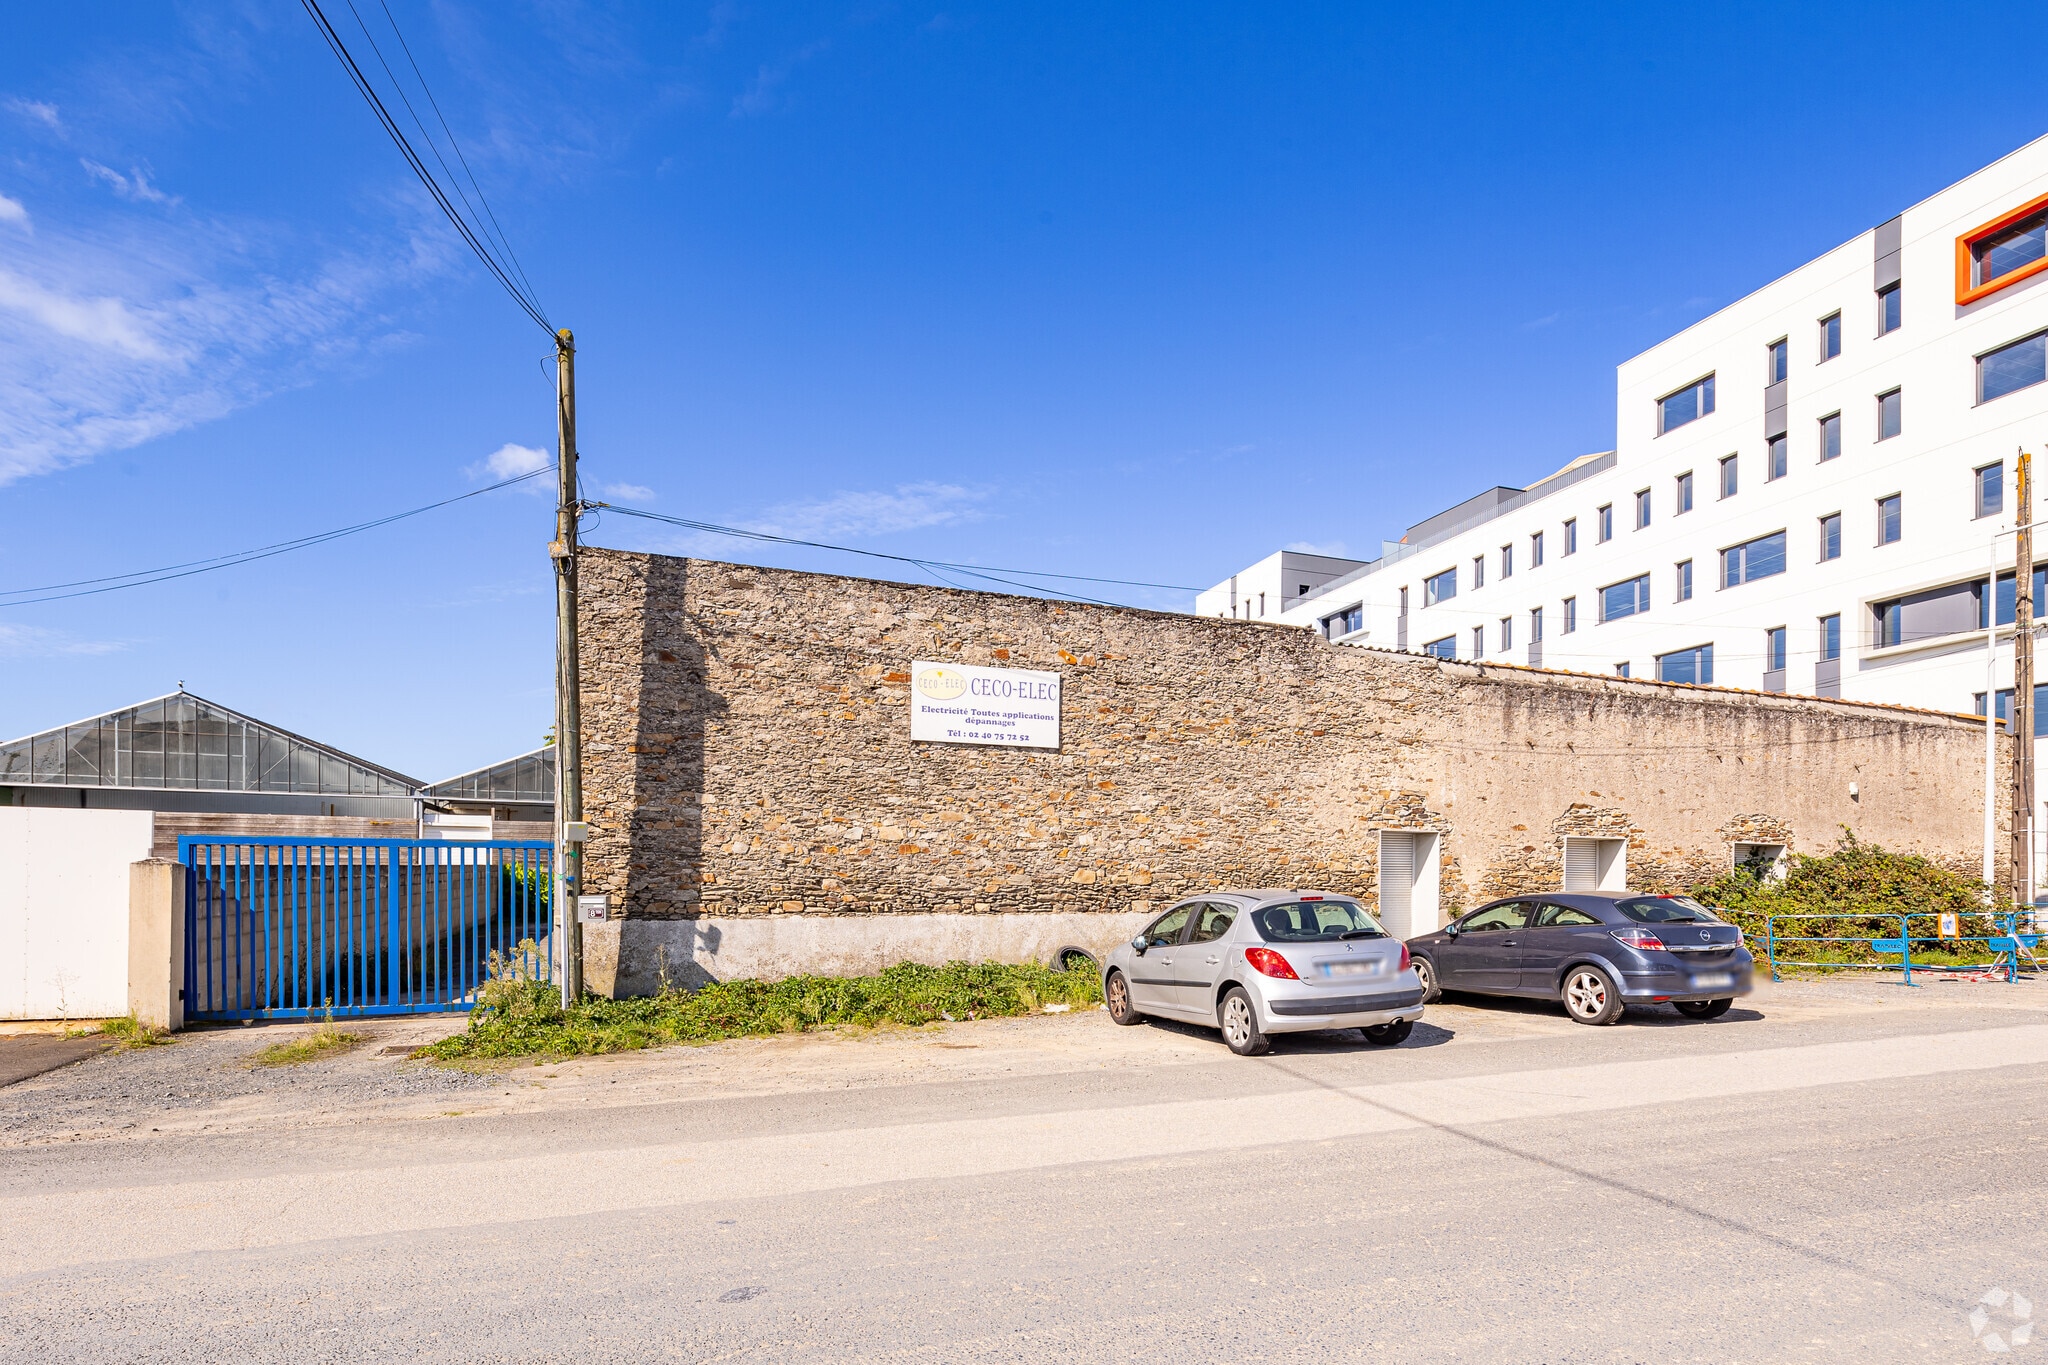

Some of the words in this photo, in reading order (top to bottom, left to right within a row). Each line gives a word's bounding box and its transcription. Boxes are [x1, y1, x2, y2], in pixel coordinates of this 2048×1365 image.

[971, 677, 1057, 701] CECO-ELEC
[921, 705, 968, 716] Electricité
[971, 708, 1000, 718] Toutes
[1002, 711, 1054, 721] applications
[965, 716, 1016, 727] dépannages
[981, 732, 992, 740] 40
[994, 733, 1005, 741] 75
[1007, 733, 1017, 741] 72
